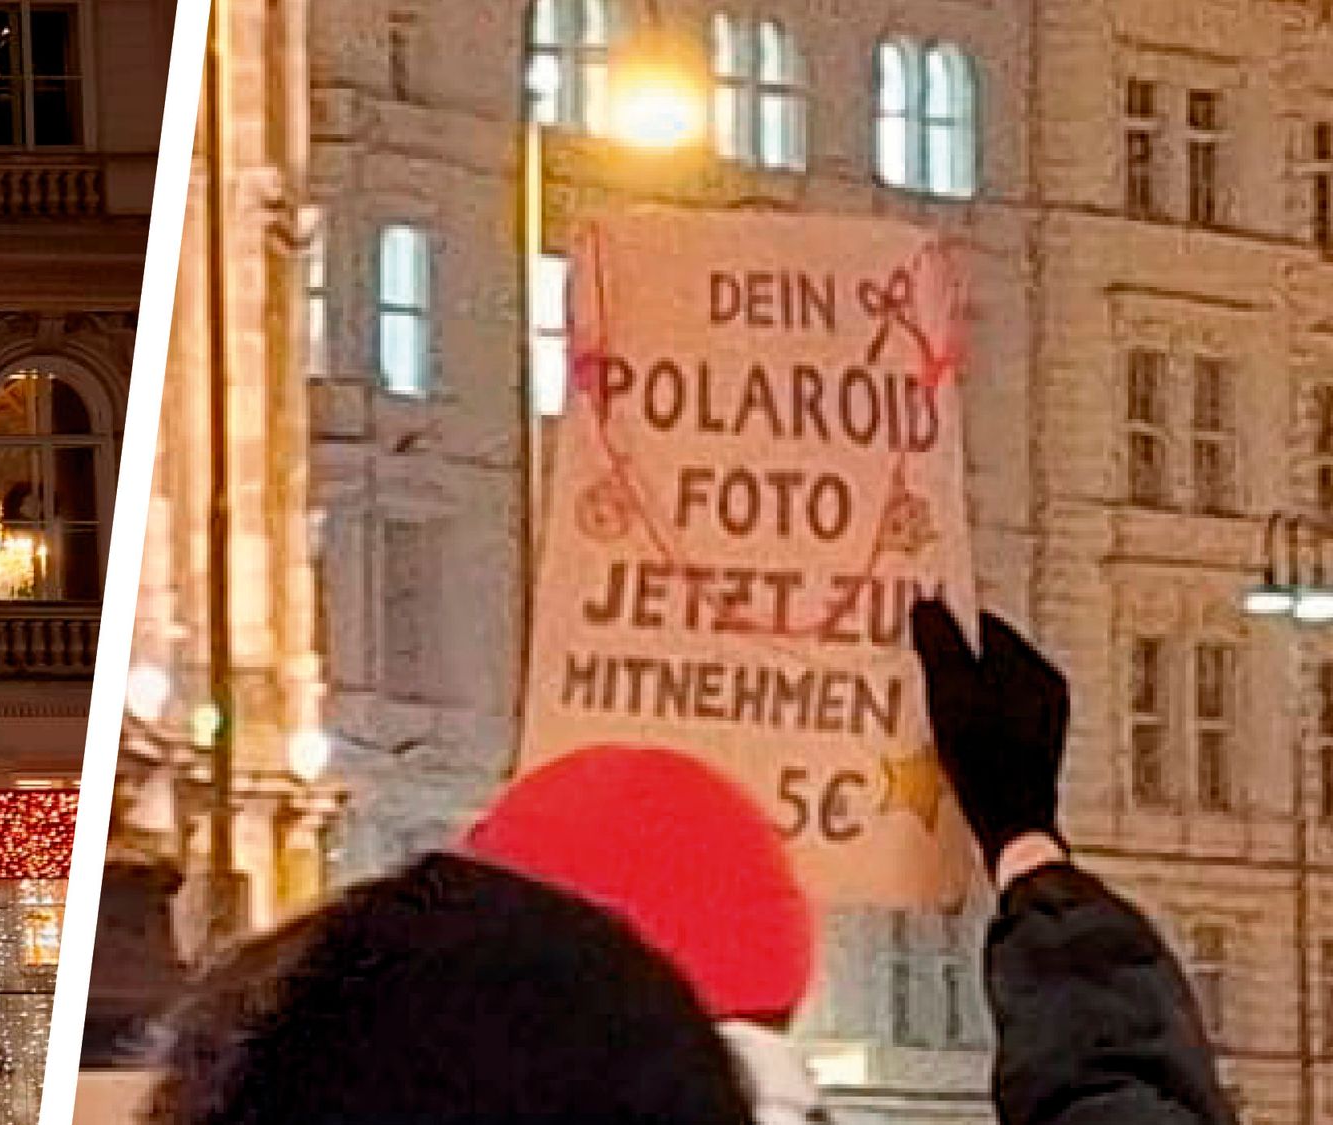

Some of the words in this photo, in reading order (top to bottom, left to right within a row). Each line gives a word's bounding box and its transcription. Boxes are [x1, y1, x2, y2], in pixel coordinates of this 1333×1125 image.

[709, 270, 835, 330] DEIN
[597, 356, 939, 453] POLAROID
[674, 465, 853, 541] FOTO
[583, 561, 804, 634] JETZT
[819, 574, 945, 646] ZU
